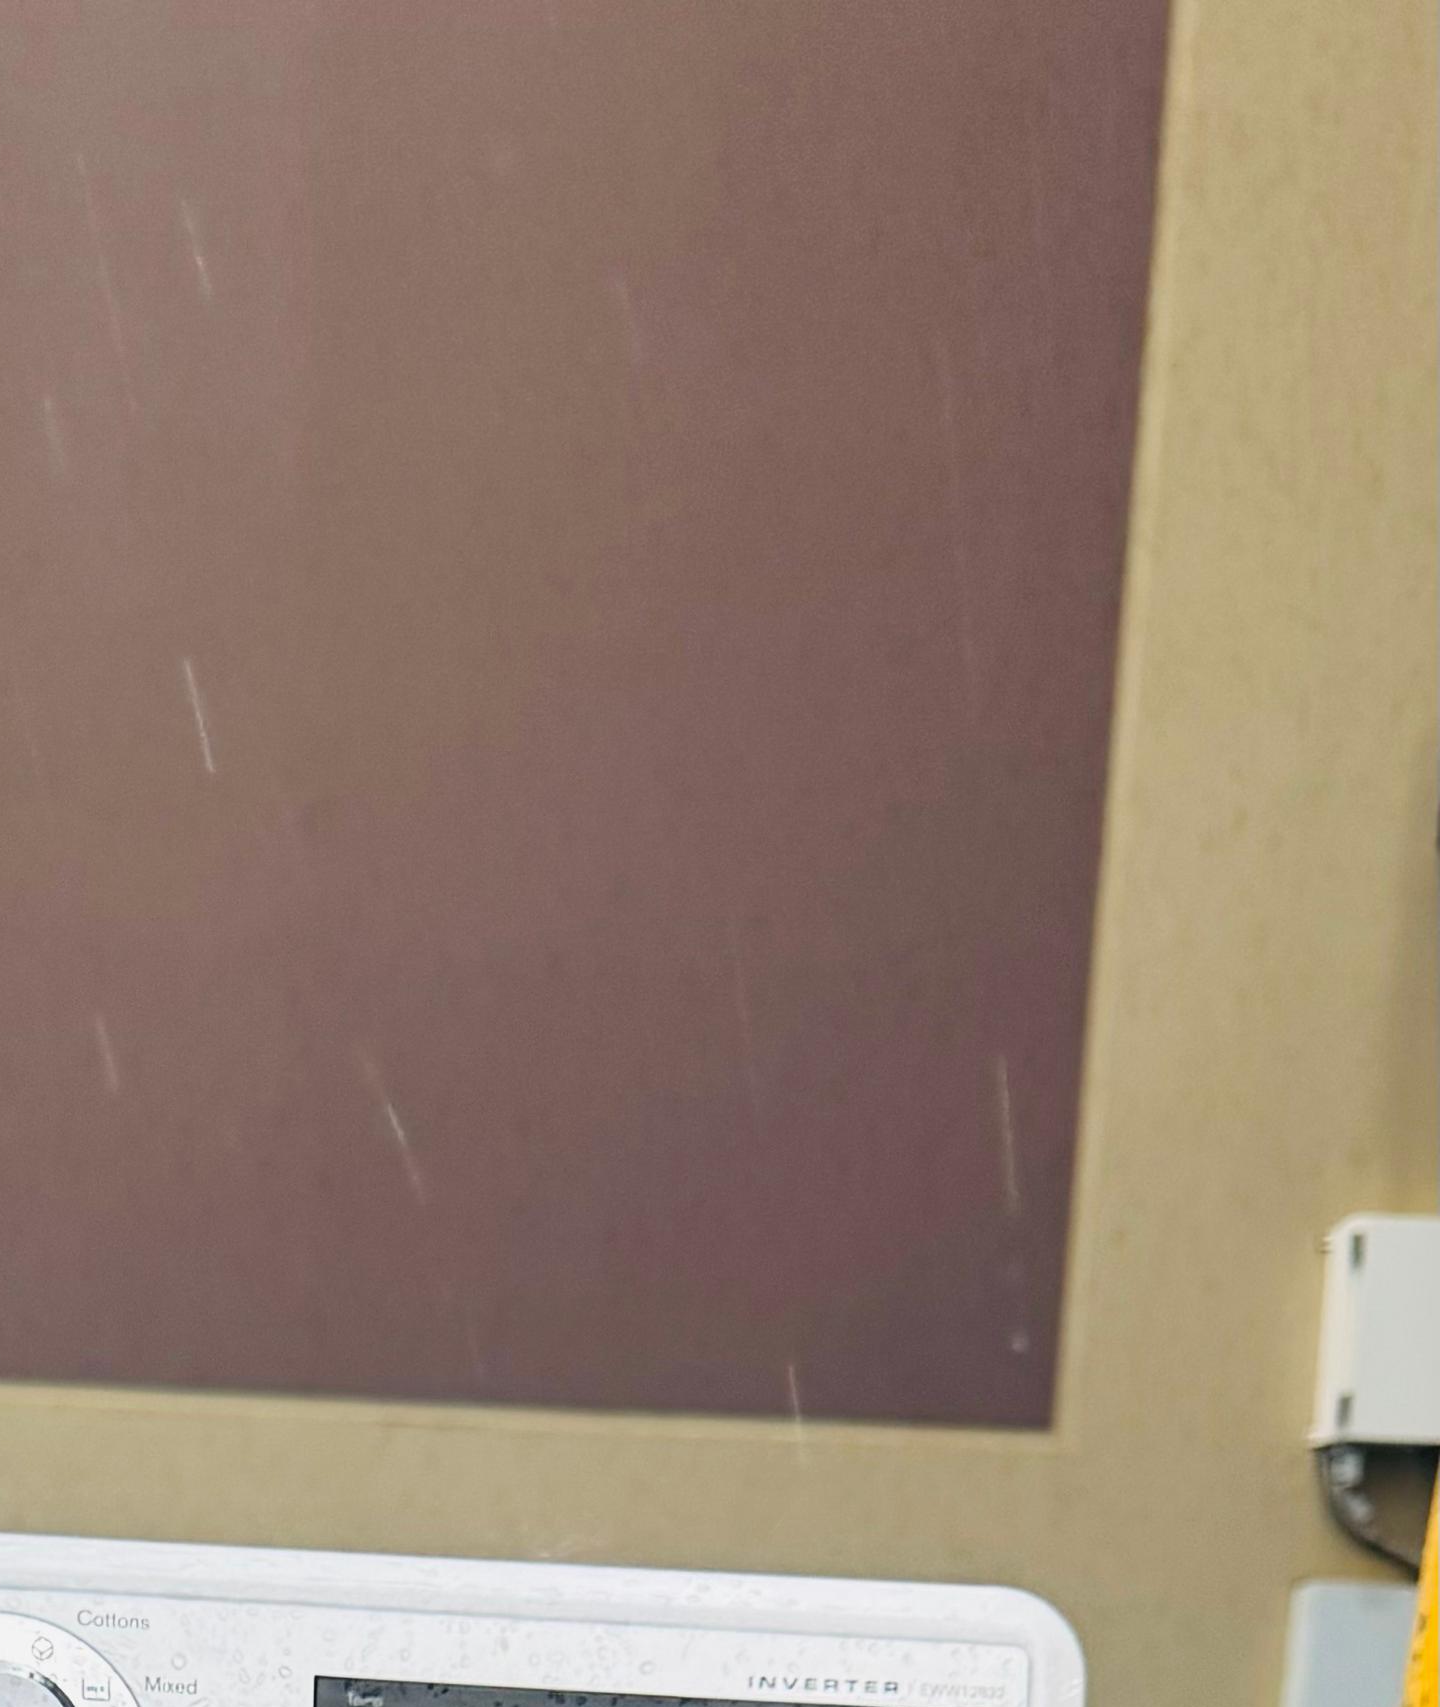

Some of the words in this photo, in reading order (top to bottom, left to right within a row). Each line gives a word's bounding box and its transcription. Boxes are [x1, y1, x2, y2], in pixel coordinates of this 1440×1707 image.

[76, 1609, 151, 1630] Cottons
[143, 1675, 199, 1696] Mixed
[746, 1675, 901, 1694] INVERTER
